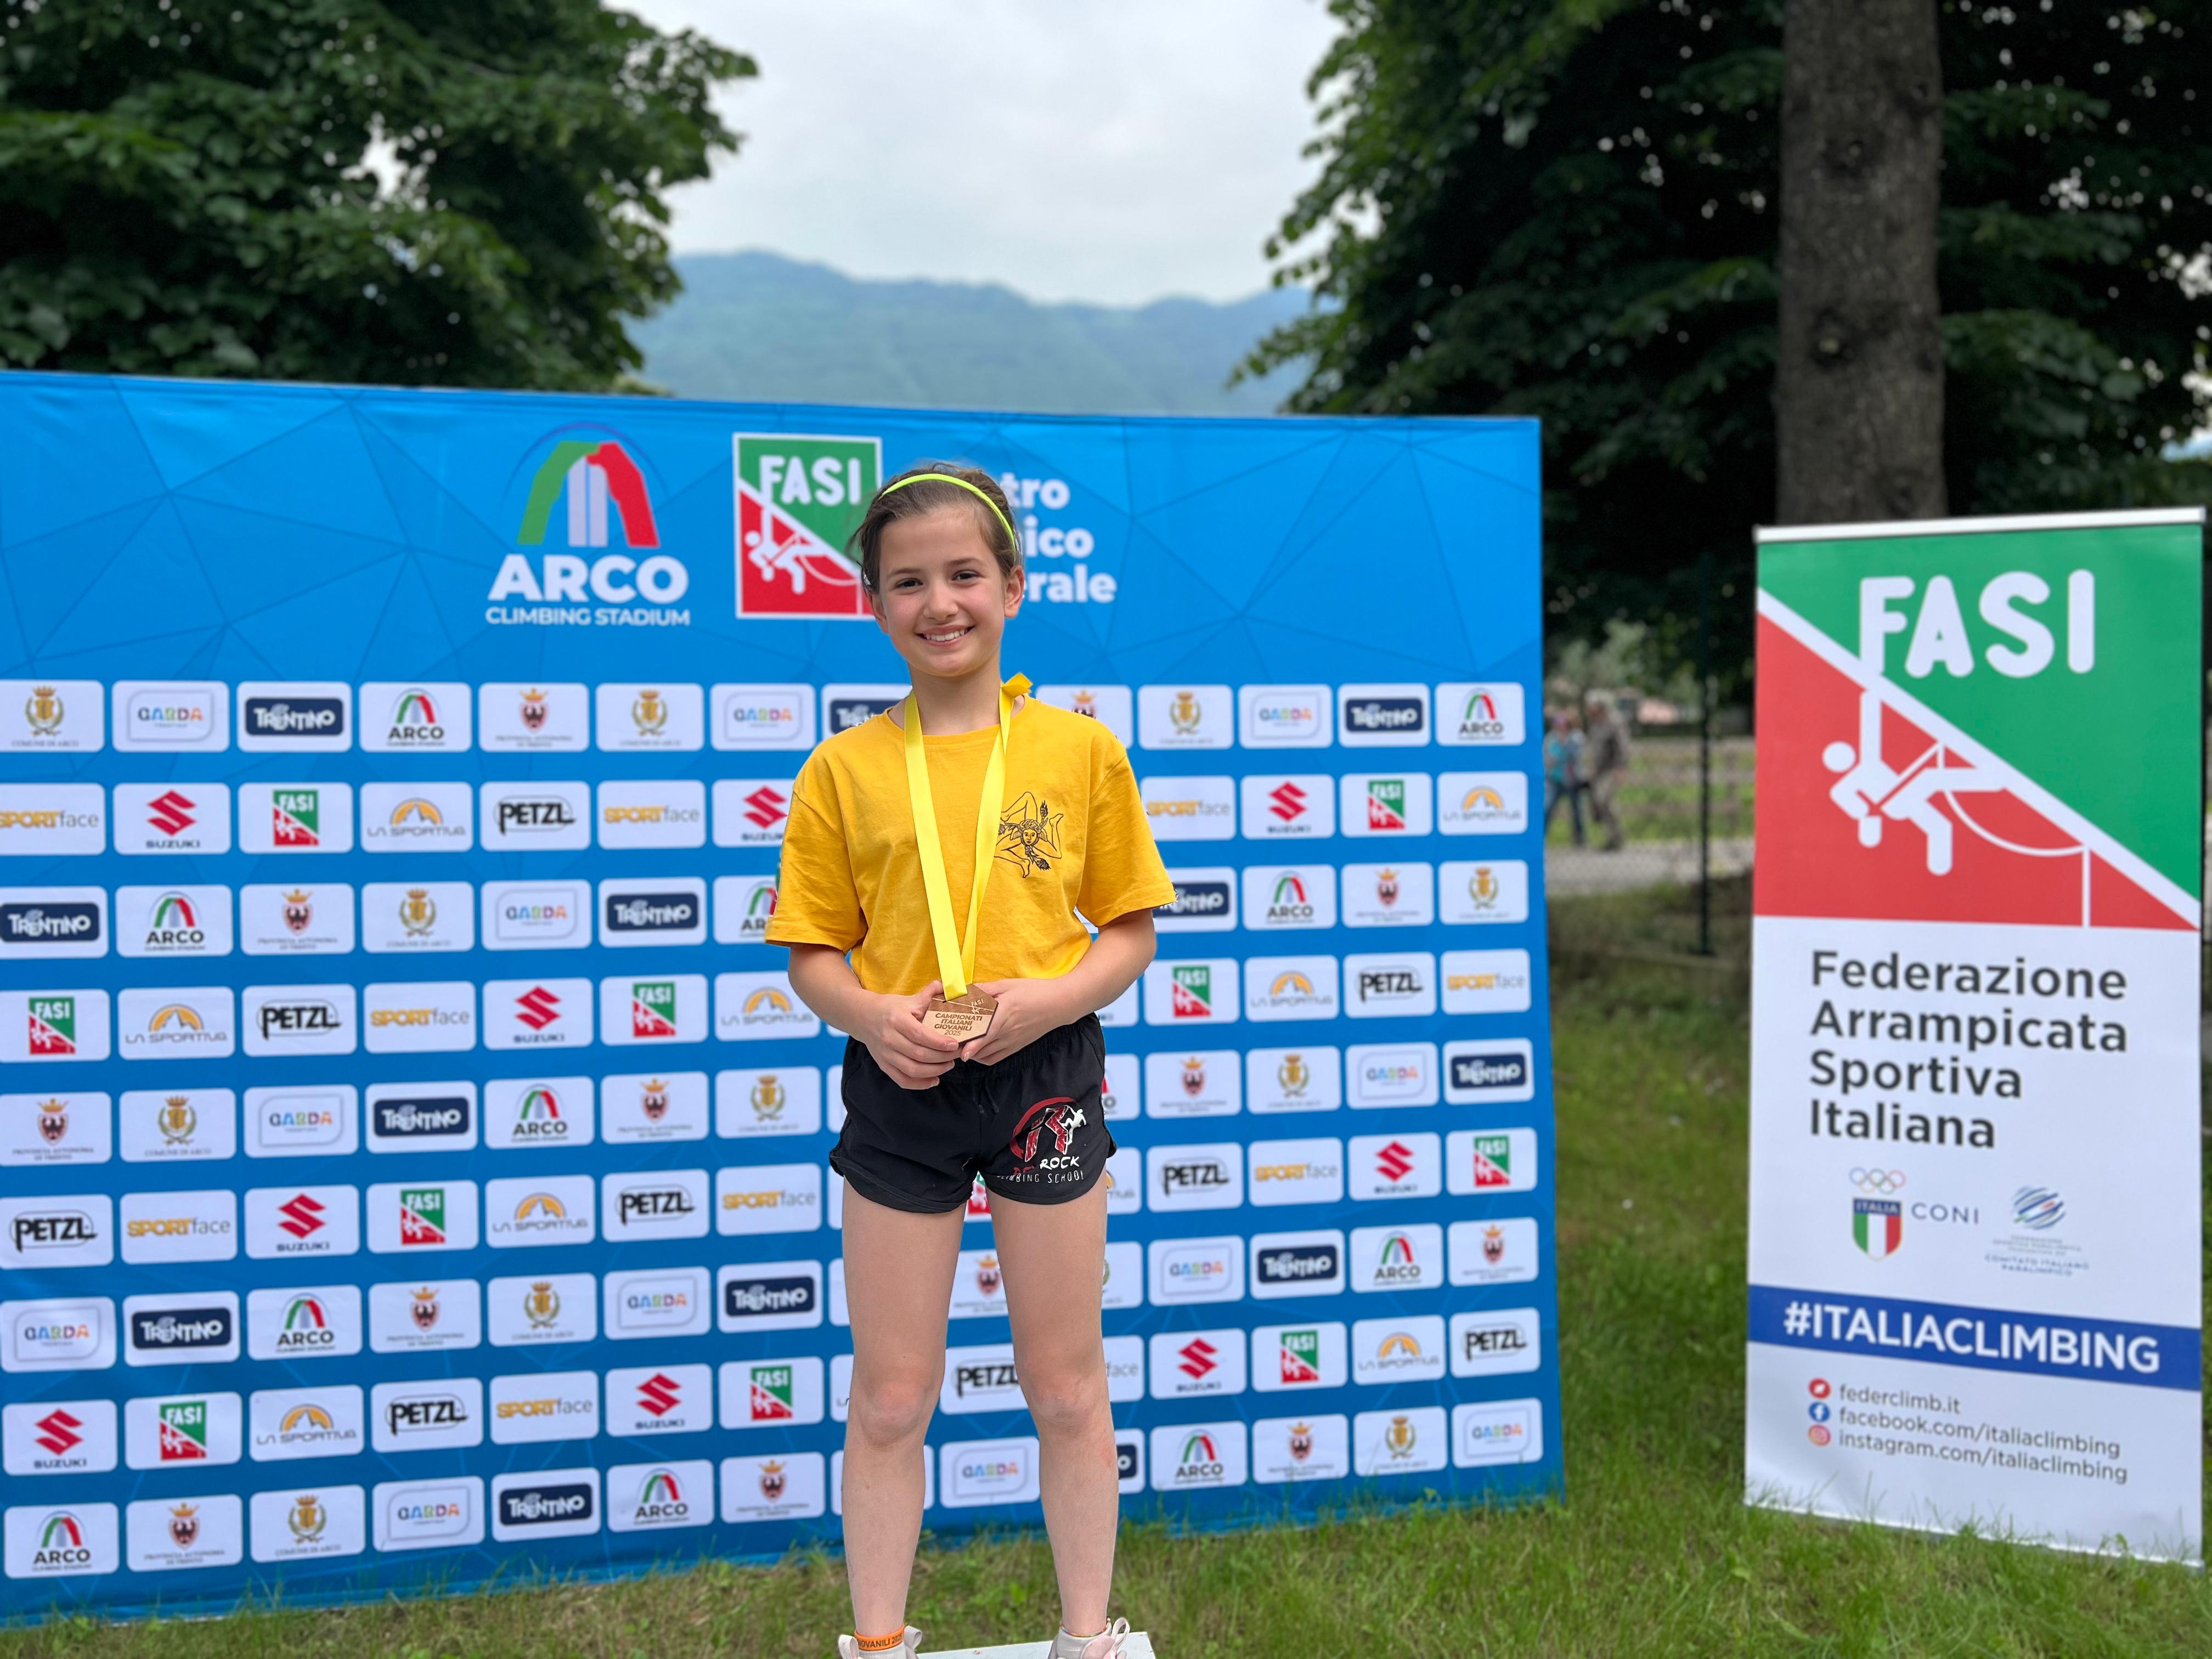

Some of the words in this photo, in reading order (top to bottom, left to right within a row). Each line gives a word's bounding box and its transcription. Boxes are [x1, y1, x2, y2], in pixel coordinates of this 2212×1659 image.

[759, 455, 861, 506] FASI
[1000, 472, 1070, 510] tro
[488, 554, 689, 604] ARCO
[1024, 563, 1118, 603] rale
[485, 607, 591, 625] CLIMBING
[595, 608, 691, 627] STADIUM
[1860, 569, 2095, 678] FASI
[138, 707, 203, 721] GARDA
[253, 704, 336, 731] TRENTINO
[734, 709, 792, 721] GARDA
[1351, 704, 1417, 727] TRENTINO
[388, 726, 444, 739] ARCO
[1458, 723, 1503, 734] ARCO
[1372, 783, 1401, 800] FASI
[278, 794, 314, 812] FASI
[499, 802, 575, 836] PETZL
[146, 840, 200, 848] SUZUKI
[506, 905, 567, 920] GARDA
[614, 899, 691, 926] TRENTINO
[1267, 905, 1313, 918] ARCO
[6, 909, 92, 937] TRENTINO
[146, 930, 205, 944] ARCO
[1178, 969, 1208, 986] FASI
[1813, 951, 2126, 999] Federazione
[637, 986, 672, 1005] FASI
[1359, 971, 1424, 1003] PETZL
[33, 1001, 71, 1020] FASI
[262, 1005, 342, 1040] PETZL
[1810, 1000, 2126, 1052] Arrampicata
[514, 1034, 564, 1043] SUZUKI
[1456, 1059, 1521, 1085] TRENTINO
[1810, 1050, 2022, 1098] Sportiva
[269, 1111, 332, 1127] GARDA
[381, 1104, 461, 1132] TRENTINO
[1811, 1099, 1994, 1148] Italiana
[513, 1121, 567, 1136] ARCO
[1478, 1139, 1506, 1156] FASI
[1040, 1156, 1080, 1170] ROCK
[1047, 1170, 1084, 1183] SCHOOL
[1163, 1163, 1231, 1197] PETZL
[406, 1193, 441, 1211] FASI
[620, 1190, 695, 1226] PETZL
[1855, 1200, 1899, 1213] ITALIA
[1911, 1203, 1979, 1224] CONI
[15, 1216, 98, 1253] PETZL
[276, 1242, 329, 1252] SUZUKI
[1263, 1250, 1331, 1279] TRENTINO
[1374, 1265, 1421, 1280] ARCO
[627, 1293, 686, 1309] GARDA
[732, 1282, 808, 1312] TRENTINO
[24, 1324, 89, 1341] GARDA
[140, 1314, 224, 1344] TRENTINO
[277, 1330, 335, 1346] ARCO
[1784, 1301, 2160, 1373] #ITALIACLIMBING
[1285, 1334, 1314, 1352] FASI
[1465, 1327, 1528, 1363] PETZL
[755, 1369, 788, 1388] FASI
[1839, 1384, 1961, 1415] federclimb.it
[165, 1405, 202, 1426] FASI
[390, 1398, 469, 1436] PETZL
[635, 1419, 685, 1430] SUZUKI
[1839, 1408, 2121, 1459] facebook.com/italiaclimbing
[34, 1458, 87, 1469] SUZUKI
[1839, 1431, 2128, 1485] instagram.com/italiaclimbing
[963, 1462, 1018, 1477] GARDA
[1175, 1463, 1223, 1478] ARCO
[398, 1502, 460, 1520] GARDA
[507, 1489, 585, 1521] TRENTINO
[635, 1502, 689, 1519] ARCO
[33, 1548, 91, 1565] ARCO
